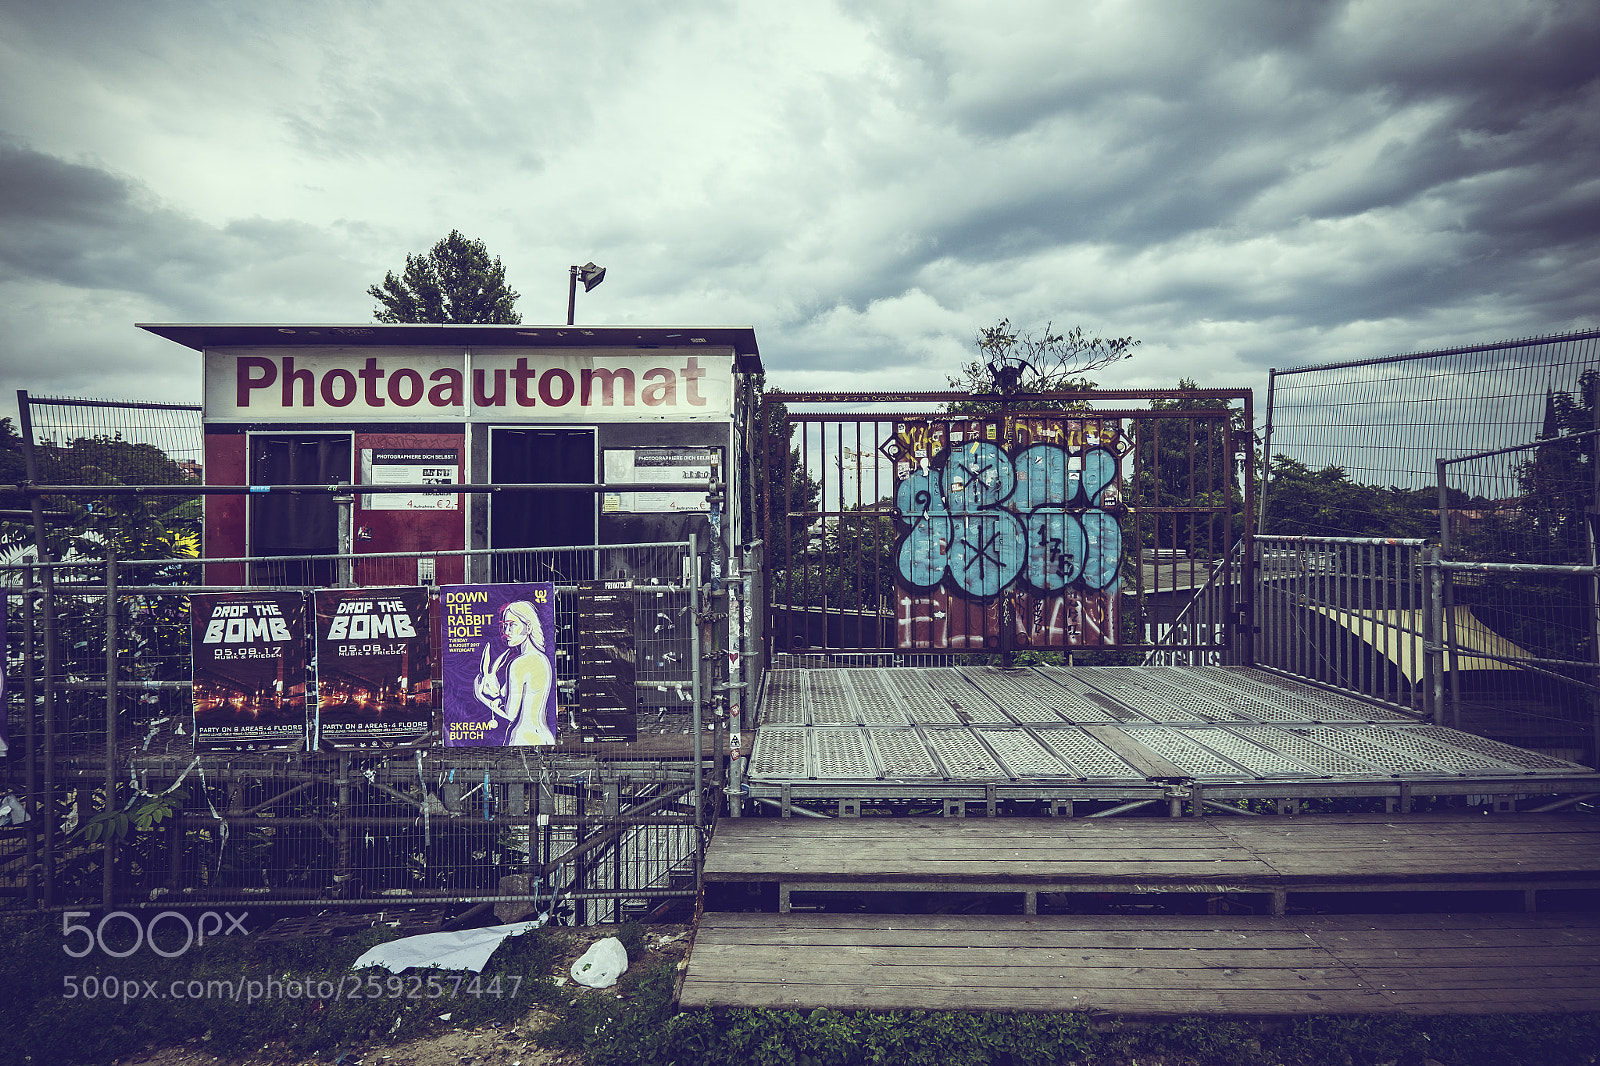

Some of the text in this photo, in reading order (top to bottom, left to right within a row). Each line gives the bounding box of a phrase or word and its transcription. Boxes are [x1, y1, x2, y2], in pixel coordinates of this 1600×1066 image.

[236, 357, 707, 407] Photoautomat
[446, 592, 488, 603] DOWN
[211, 604, 282, 618] DROP THE
[337, 601, 407, 614] DROP THE
[446, 604, 472, 614] THE
[447, 615, 494, 626] RABBIT
[203, 617, 292, 644] BOMB
[327, 614, 417, 640] BOMB
[448, 626, 483, 637] HOLE
[214, 646, 282, 656] 05.08.17
[339, 643, 407, 652] 05.08.17
[450, 722, 492, 731] SKREAM
[450, 731, 484, 740] BUTCH
